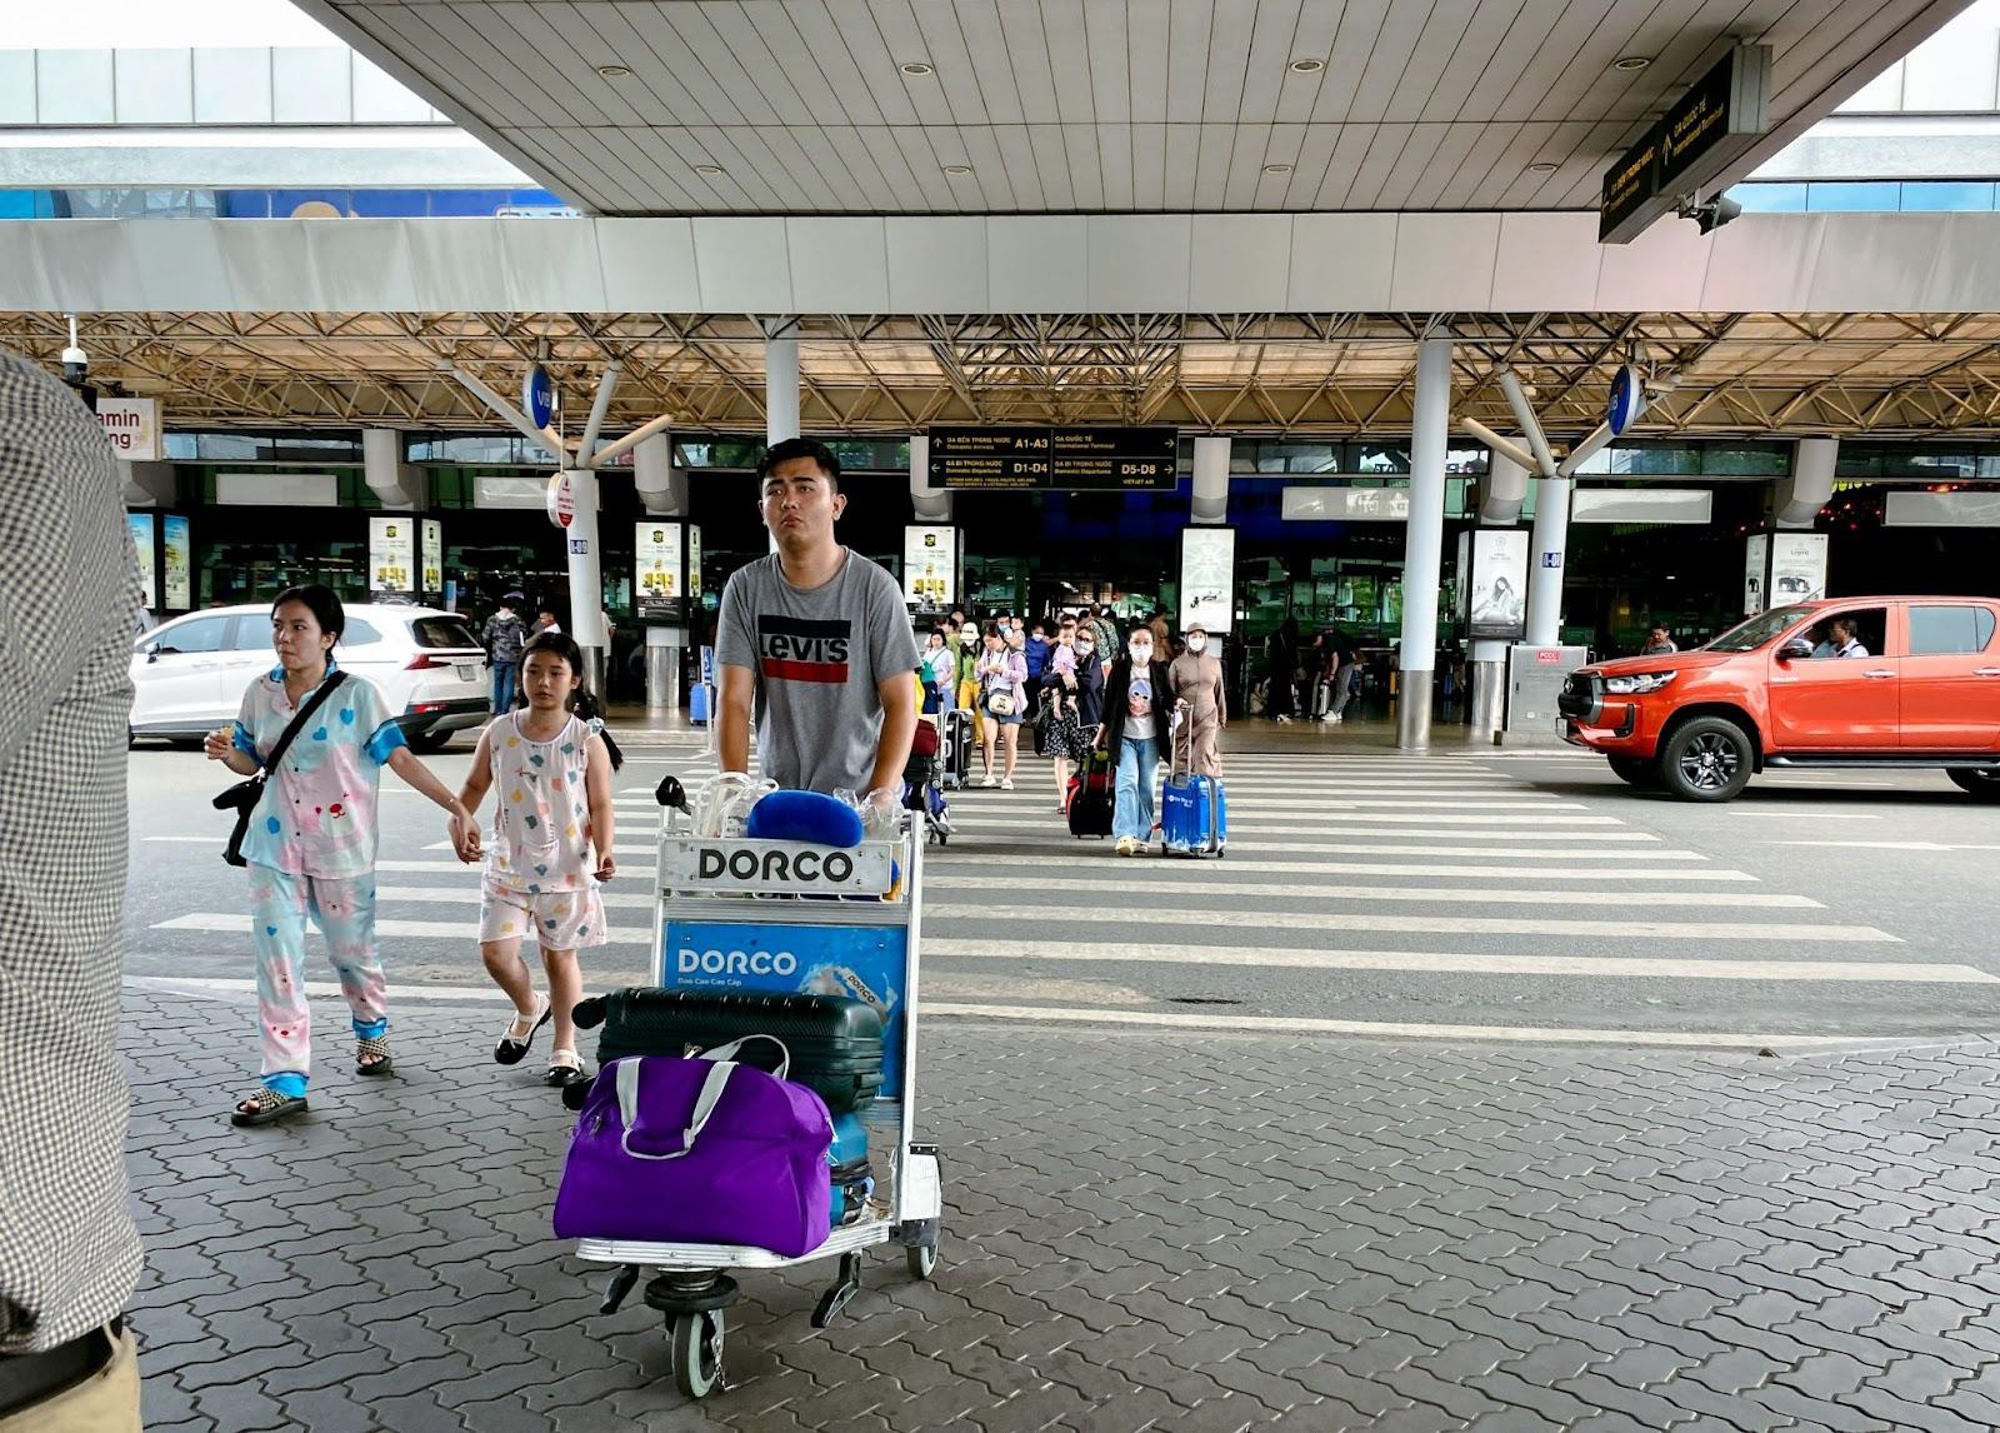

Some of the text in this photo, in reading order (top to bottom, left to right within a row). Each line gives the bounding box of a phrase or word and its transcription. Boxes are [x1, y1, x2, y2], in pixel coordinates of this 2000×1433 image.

[1014, 438, 1049, 449] A1-A3
[1013, 463, 1048, 473] D1-D4
[1121, 464, 1156, 474] D5-D8
[699, 849, 853, 882] DORCO
[678, 949, 797, 975] DORCO
[848, 975, 876, 1003] DORCO
